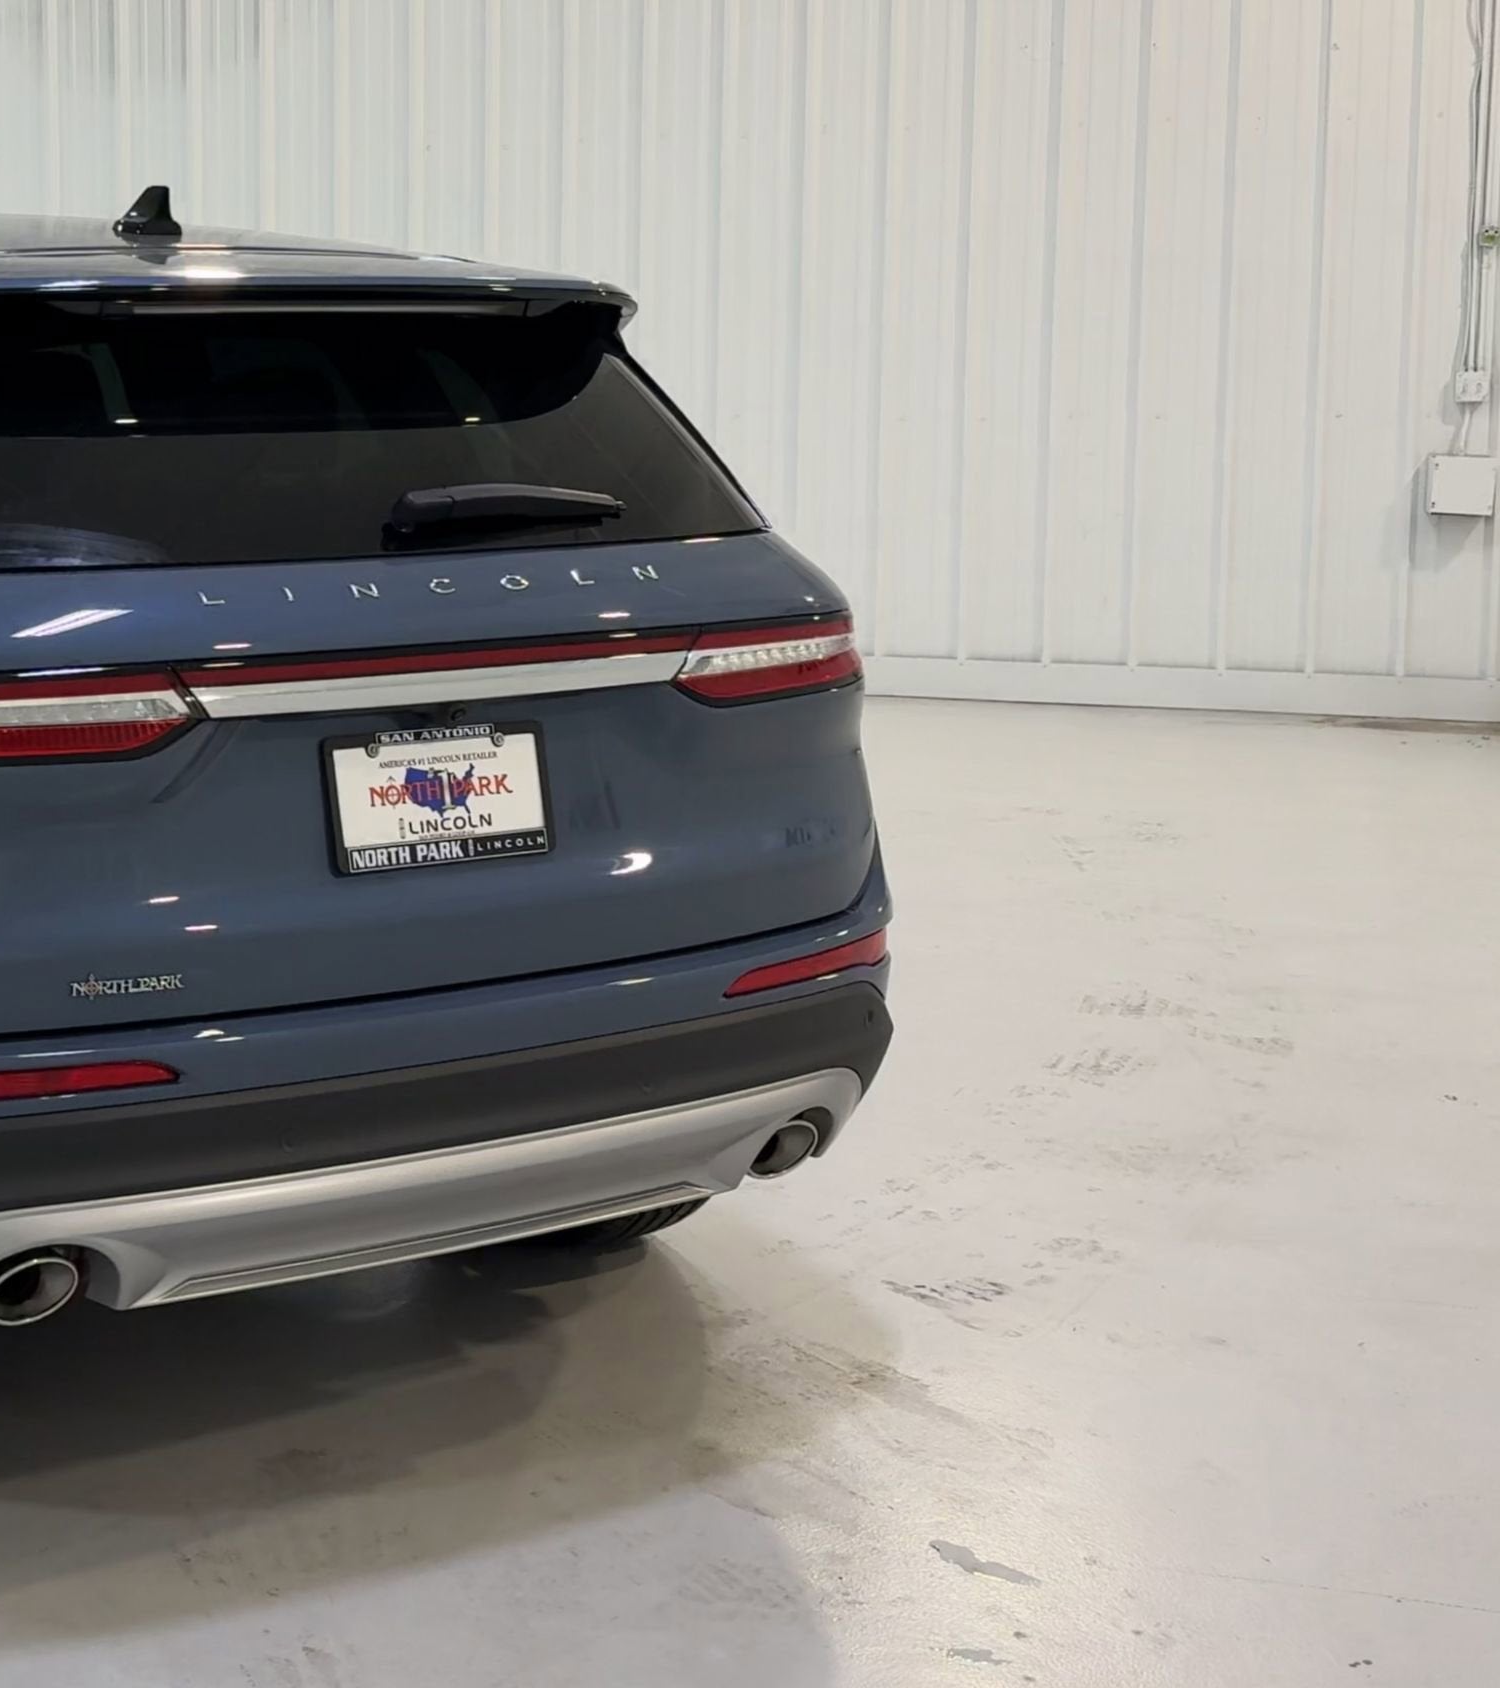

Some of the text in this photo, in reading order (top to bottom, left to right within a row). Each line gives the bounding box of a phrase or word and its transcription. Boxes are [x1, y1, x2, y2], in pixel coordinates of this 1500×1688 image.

[199, 564, 660, 606] LINCOLN
[380, 726, 491, 743] SAN ANTONIO
[427, 755, 461, 766] LINCOLN
[462, 750, 498, 762] RETAILER
[368, 773, 514, 808] NORTH PARK
[408, 813, 493, 835] LINCOLN
[351, 846, 412, 869] NORTH
[416, 840, 464, 861] PARK
[476, 835, 545, 852] LINCOLN
